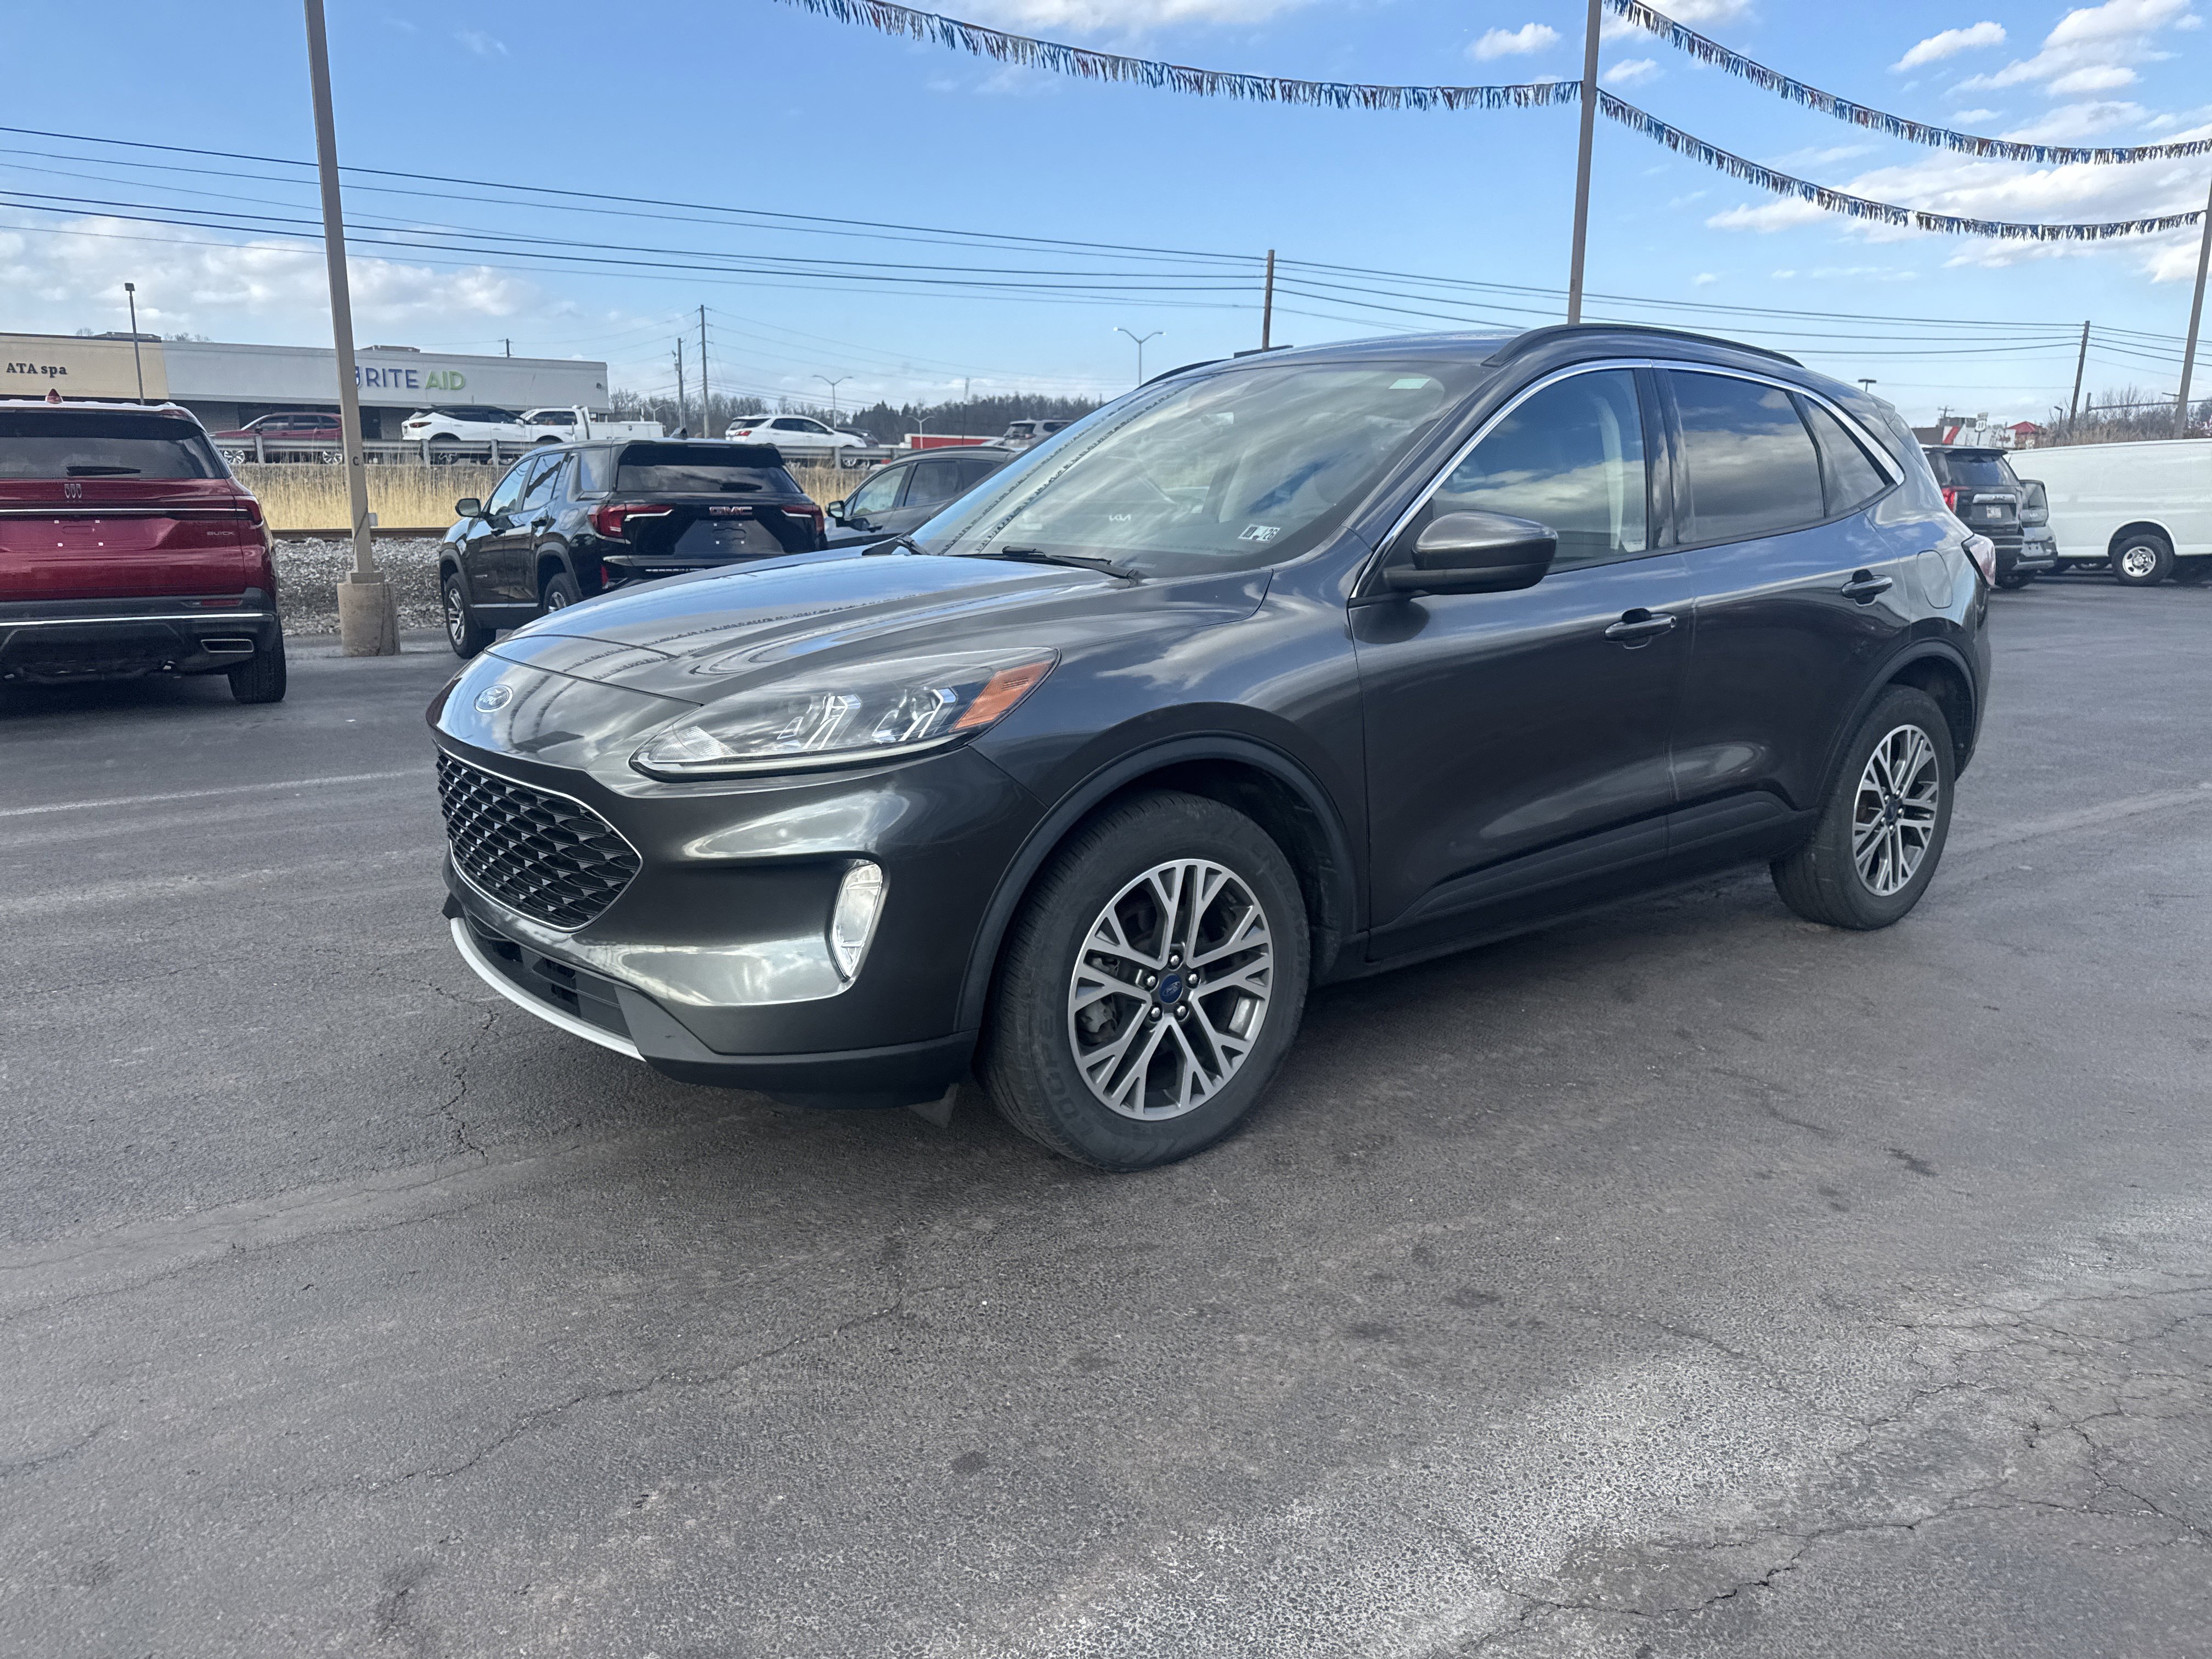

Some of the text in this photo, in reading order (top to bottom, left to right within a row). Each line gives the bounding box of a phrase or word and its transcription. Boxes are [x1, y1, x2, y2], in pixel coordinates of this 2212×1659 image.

[6, 362, 67, 378] ATA spa
[365, 368, 466, 390] RITE AID
[353, 456, 359, 466] C
[709, 506, 753, 516] GMC
[1263, 528, 1278, 540] 26
